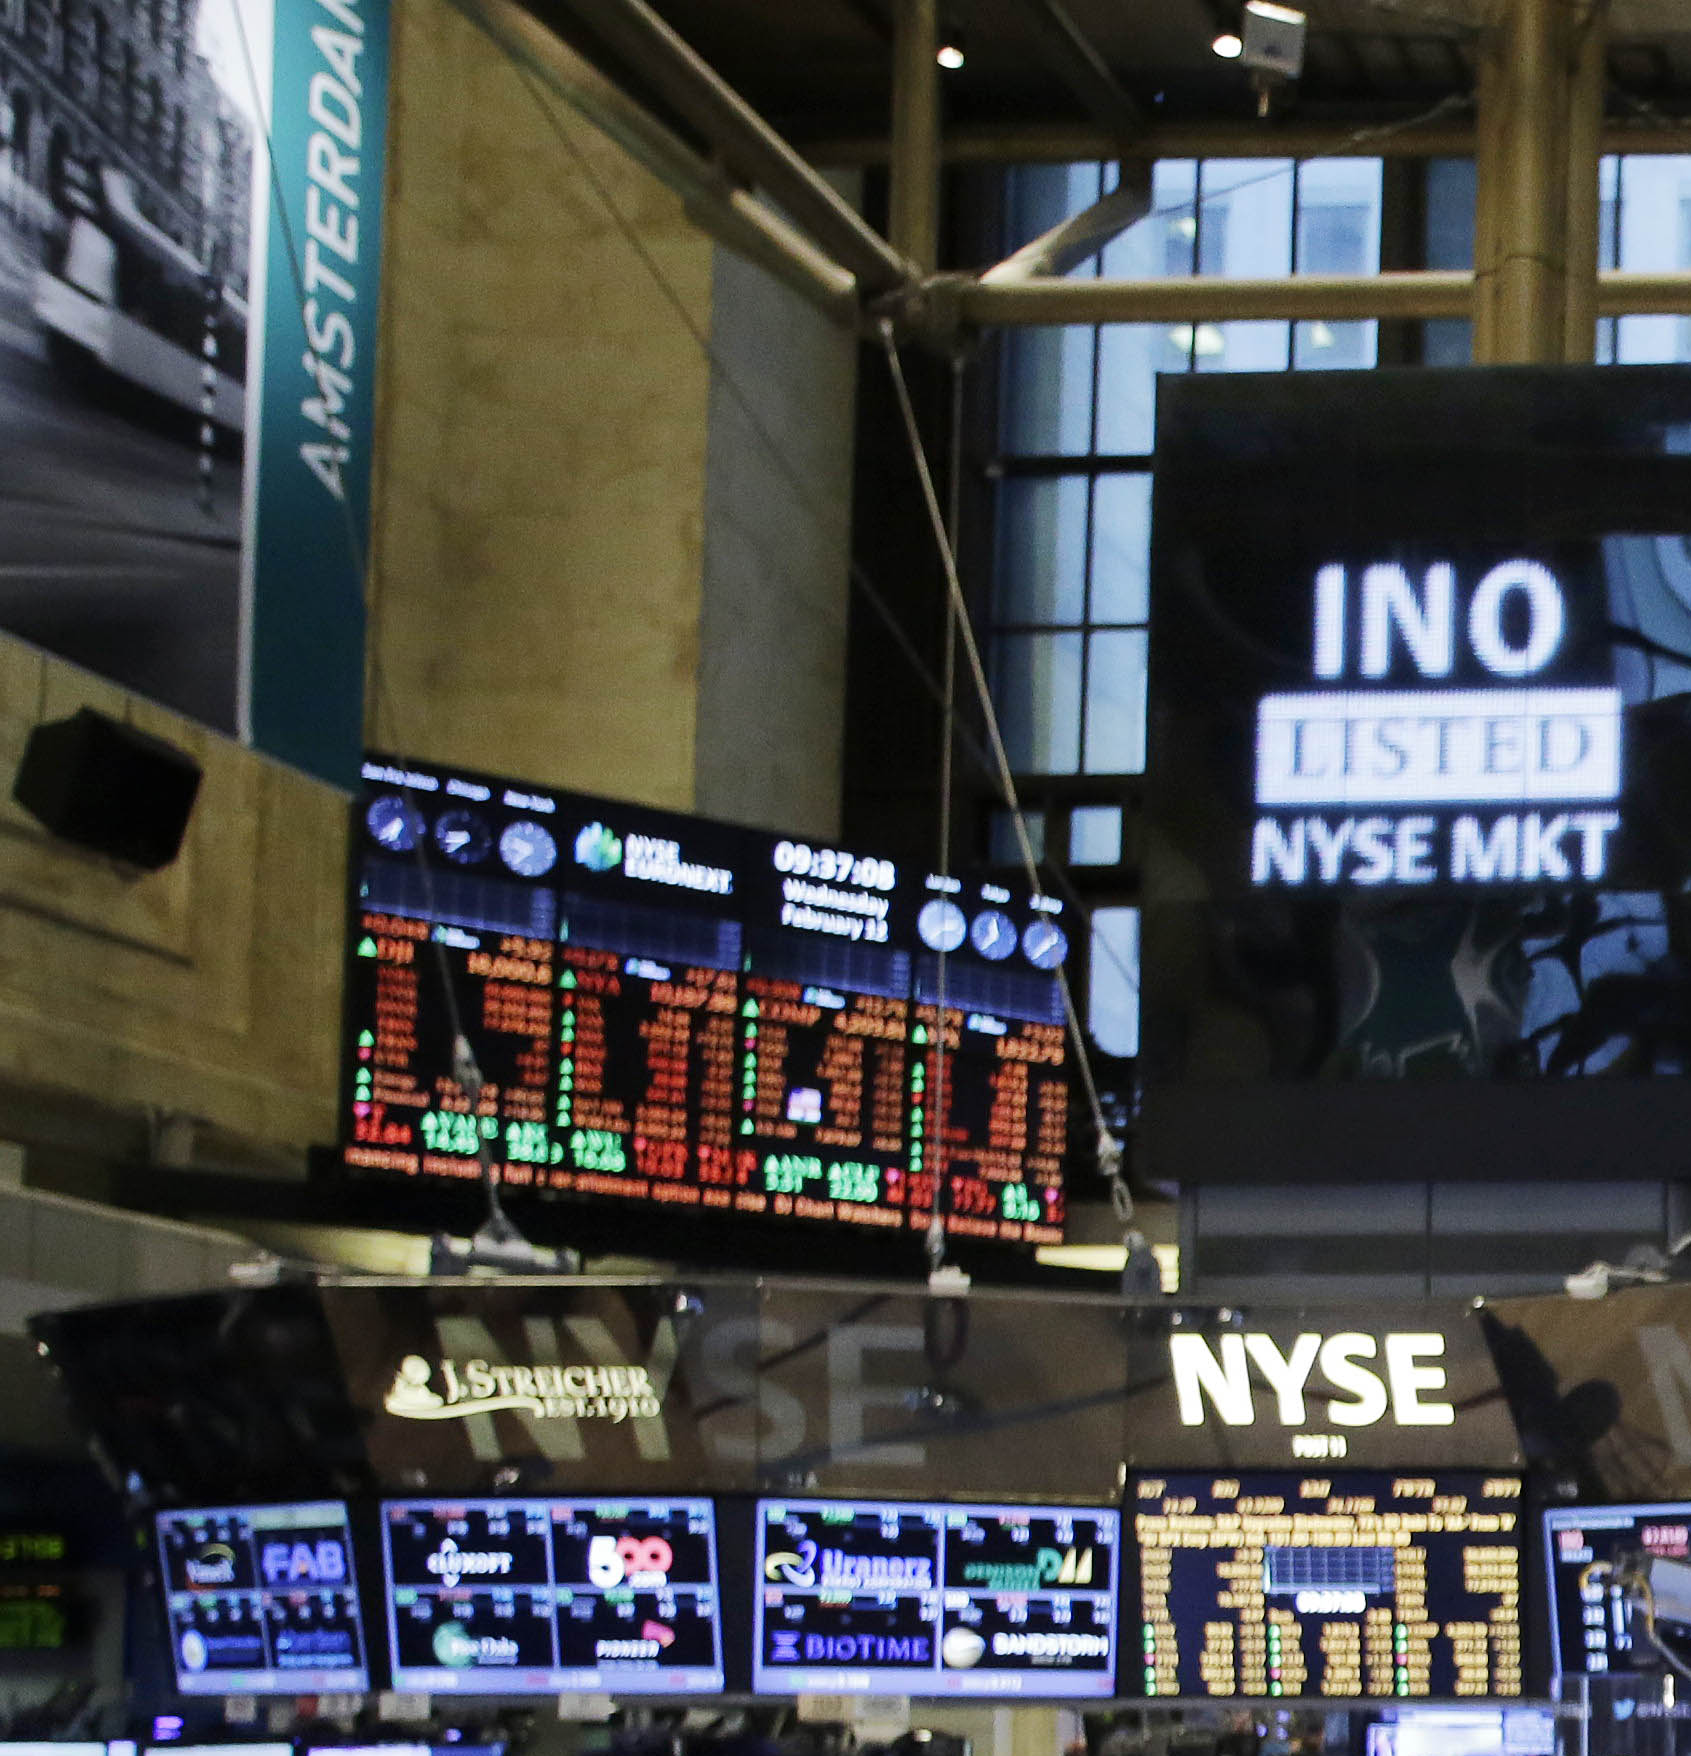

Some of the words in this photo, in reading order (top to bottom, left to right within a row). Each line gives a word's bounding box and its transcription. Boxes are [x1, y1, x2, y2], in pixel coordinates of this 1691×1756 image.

[1313, 558, 1567, 679] INO
[1288, 713, 1593, 780] LISTED
[774, 840, 896, 891] 09:37:08
[1251, 814, 1438, 886] NYSE
[1449, 808, 1621, 884] MKT
[1169, 1332, 1455, 1426] NYSE
[805, 1634, 929, 1662] BIOTIME
